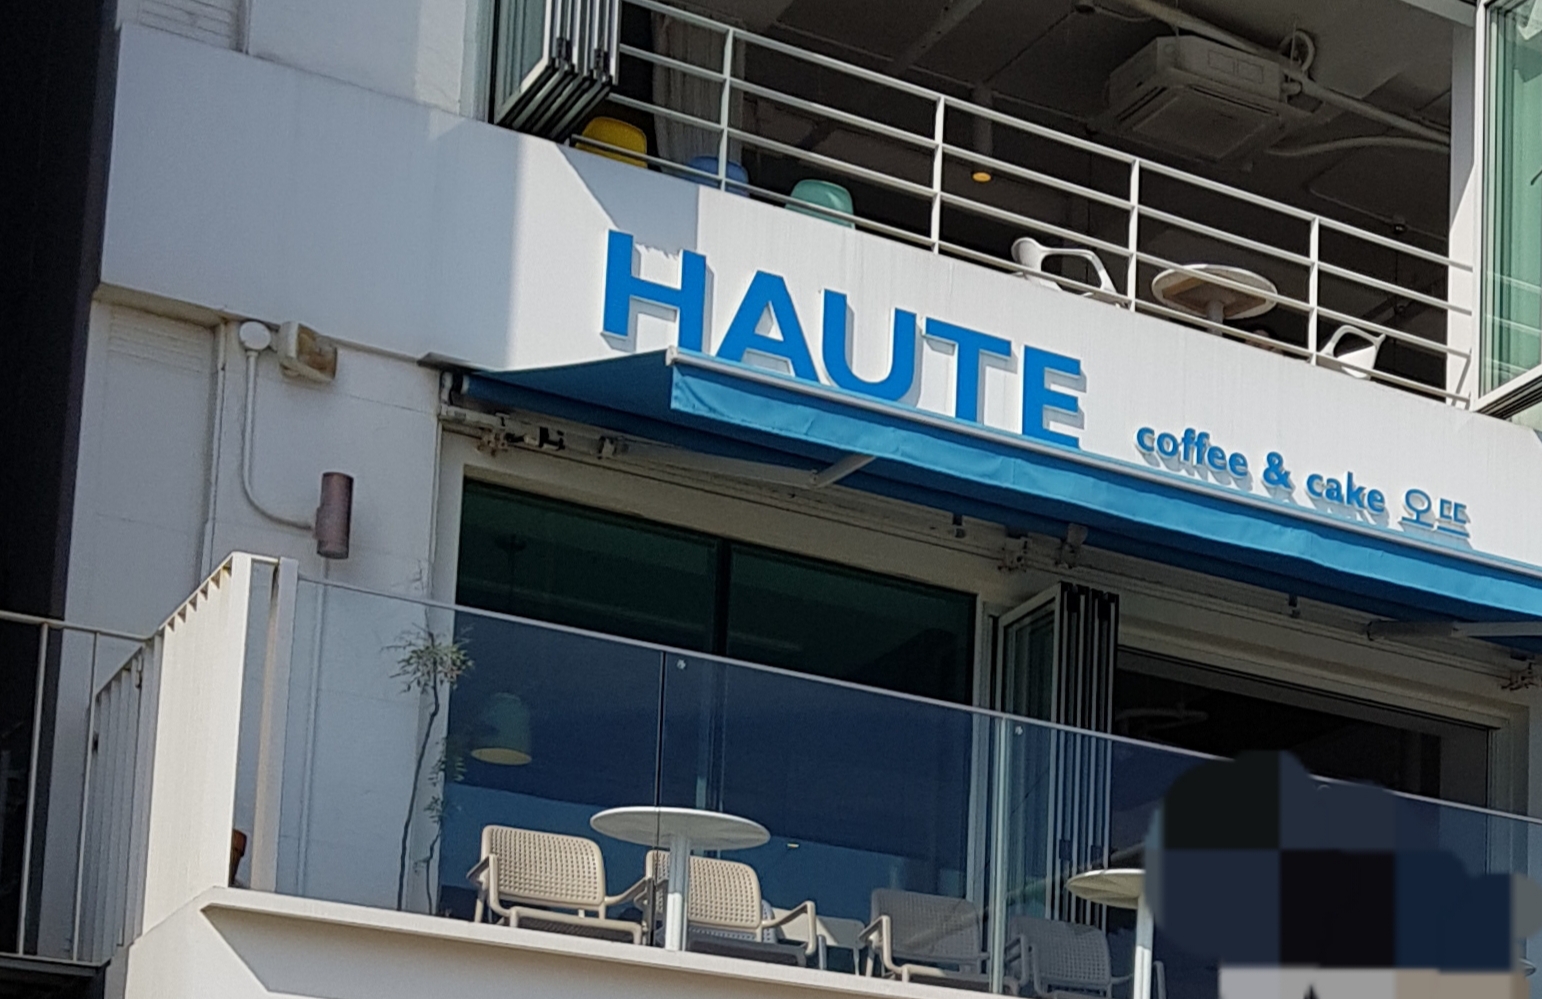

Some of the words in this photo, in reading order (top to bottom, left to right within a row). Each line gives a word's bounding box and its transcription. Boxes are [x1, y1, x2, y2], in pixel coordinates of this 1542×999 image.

[603, 229, 1081, 449] HAUTE
[1136, 427, 1249, 477] coffee
[1263, 451, 1292, 489] &
[1306, 471, 1386, 514] cake
